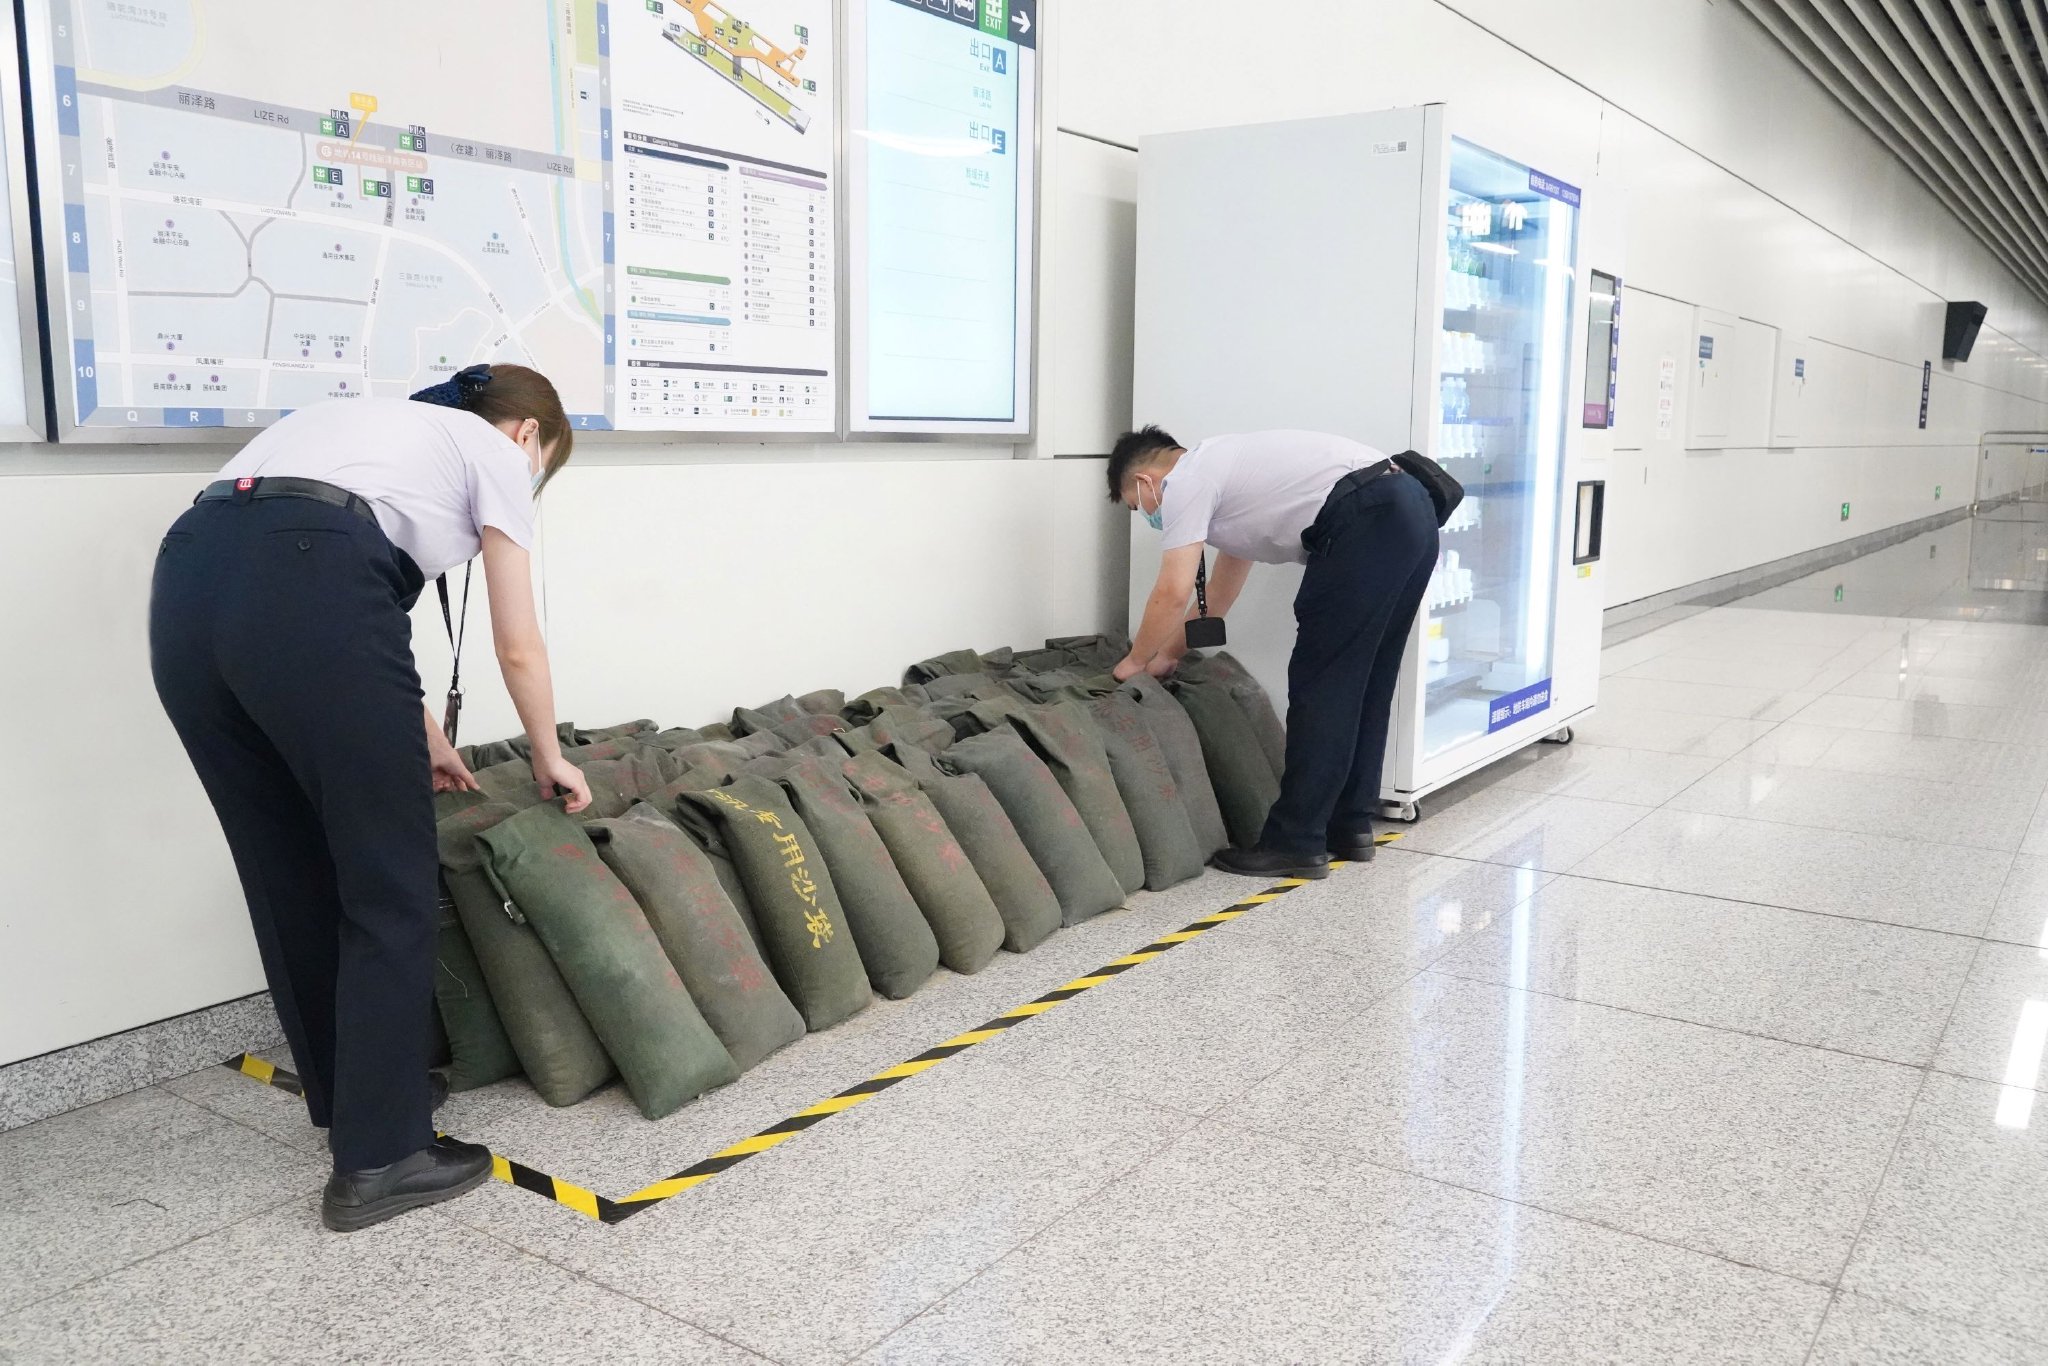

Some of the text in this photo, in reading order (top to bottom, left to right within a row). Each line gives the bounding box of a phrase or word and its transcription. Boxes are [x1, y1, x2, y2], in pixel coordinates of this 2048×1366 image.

[985, 15, 1002, 30] EXIT
[58, 26, 66, 37] 5
[600, 24, 606, 34] 3
[970, 37, 990, 60] 出口
[996, 55, 1004, 70] A
[602, 77, 608, 87] 4
[62, 94, 72, 107] 6
[178, 91, 216, 110] 丽泽路
[254, 109, 289, 124] LIZE Rd
[338, 125, 346, 135] A
[603, 130, 609, 140] 5
[970, 121, 990, 140] 出口
[416, 139, 423, 149] B
[995, 133, 1002, 150] E
[485, 147, 512, 163] 丽泽路
[67, 164, 75, 176] 7
[547, 163, 562, 172] LIZE
[332, 172, 339, 182] E
[381, 185, 388, 194] D
[423, 182, 430, 191] C
[605, 181, 610, 191] 6
[72, 232, 81, 244] 8
[606, 233, 611, 243] 7
[77, 300, 85, 311] 9
[607, 334, 613, 344] 9
[78, 367, 94, 378] 10
[605, 384, 614, 394] 10
[127, 411, 138, 422] Q
[190, 412, 199, 422] R
[247, 412, 255, 422] S
[581, 417, 587, 426] Z
